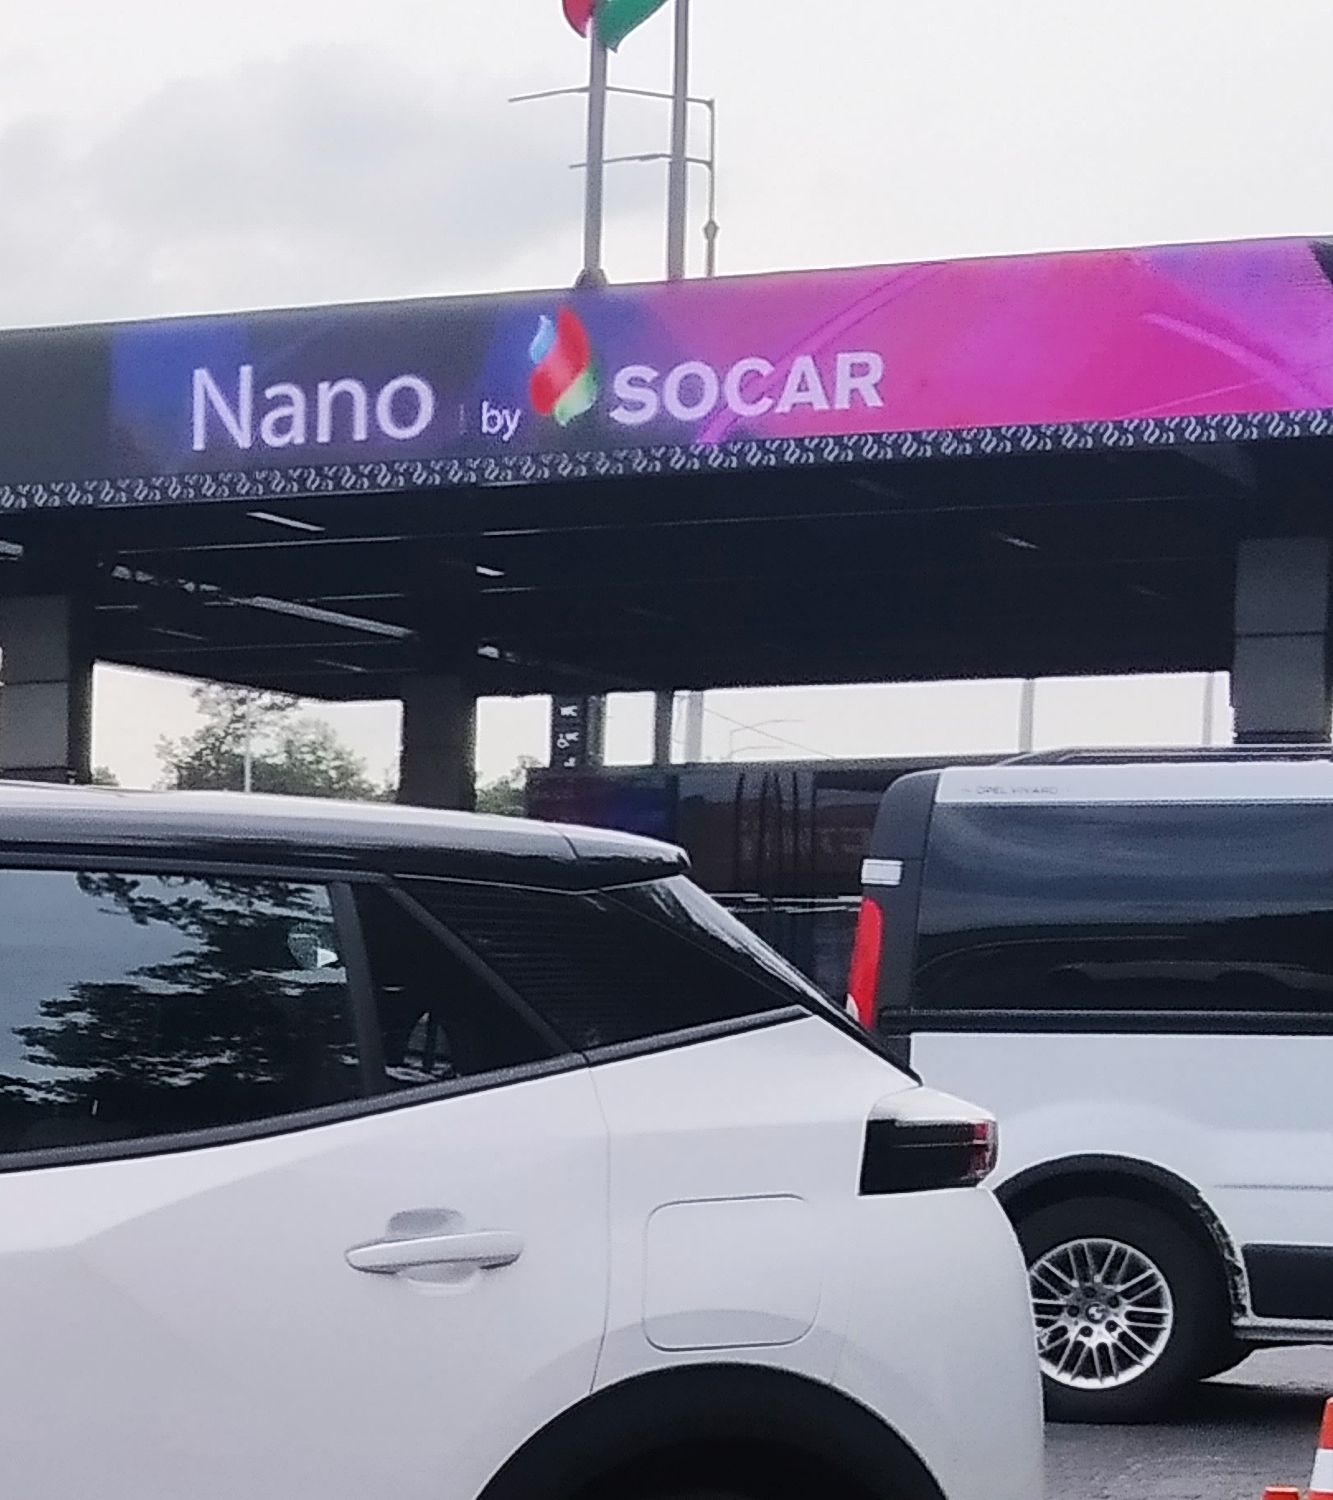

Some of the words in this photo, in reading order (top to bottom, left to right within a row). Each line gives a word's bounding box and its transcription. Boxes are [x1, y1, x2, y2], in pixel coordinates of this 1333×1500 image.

[190, 364, 435, 452] Nano
[480, 400, 522, 440] by
[609, 350, 885, 427] SOCAR
